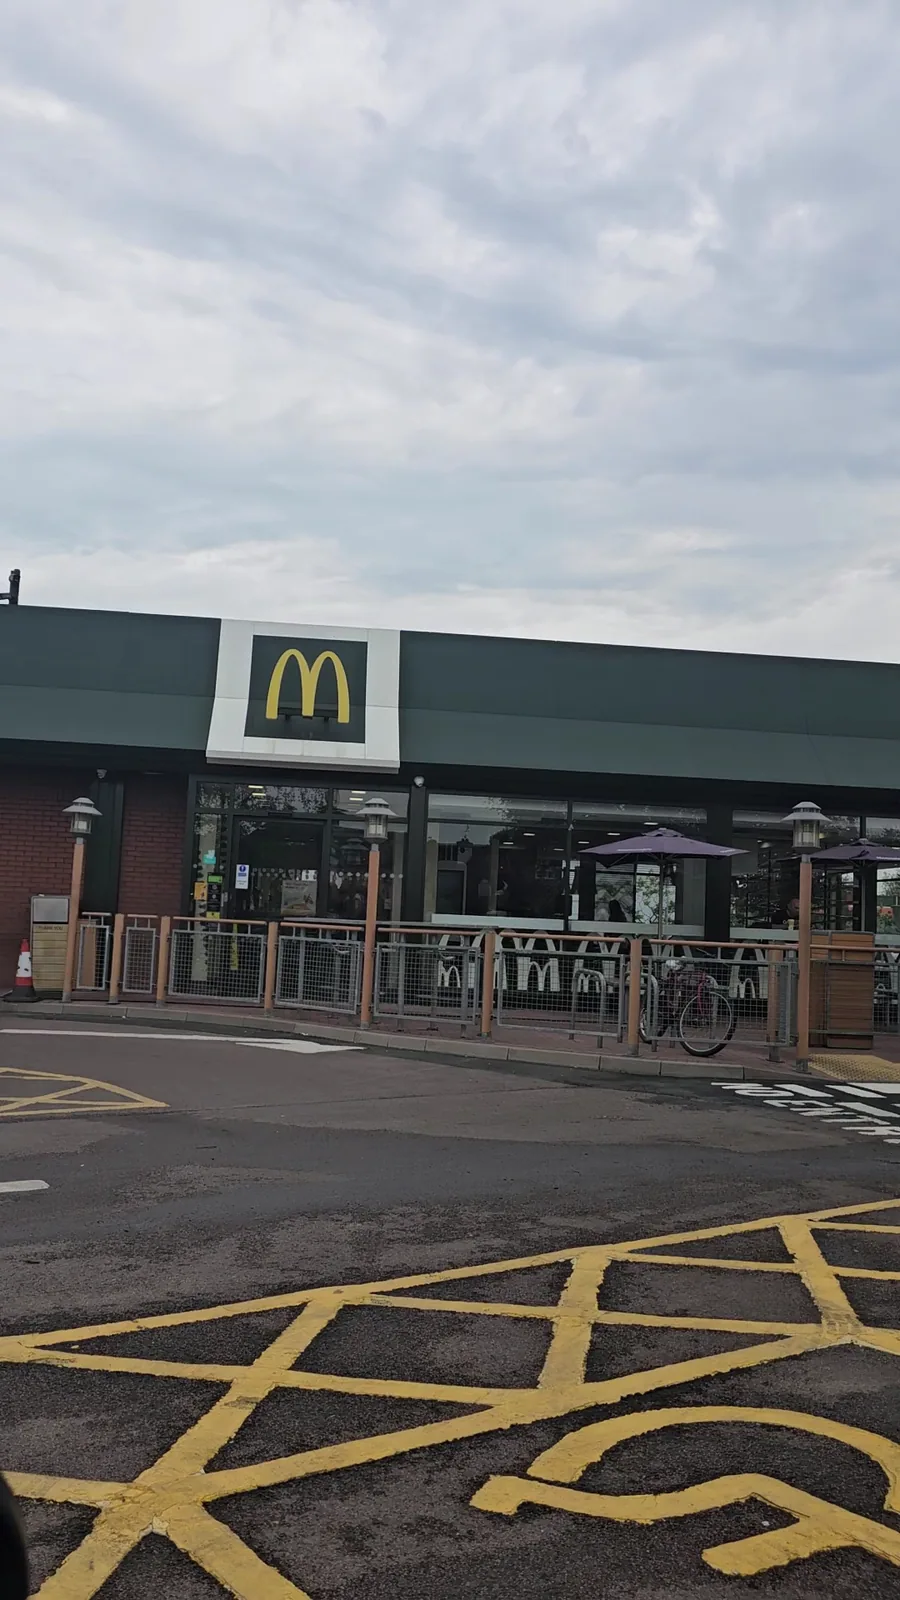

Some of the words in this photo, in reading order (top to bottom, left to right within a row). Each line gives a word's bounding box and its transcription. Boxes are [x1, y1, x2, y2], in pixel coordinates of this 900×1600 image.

[265, 648, 350, 724] M
[711, 1082, 795, 1097] NO
[763, 1099, 900, 1144] ENTR
